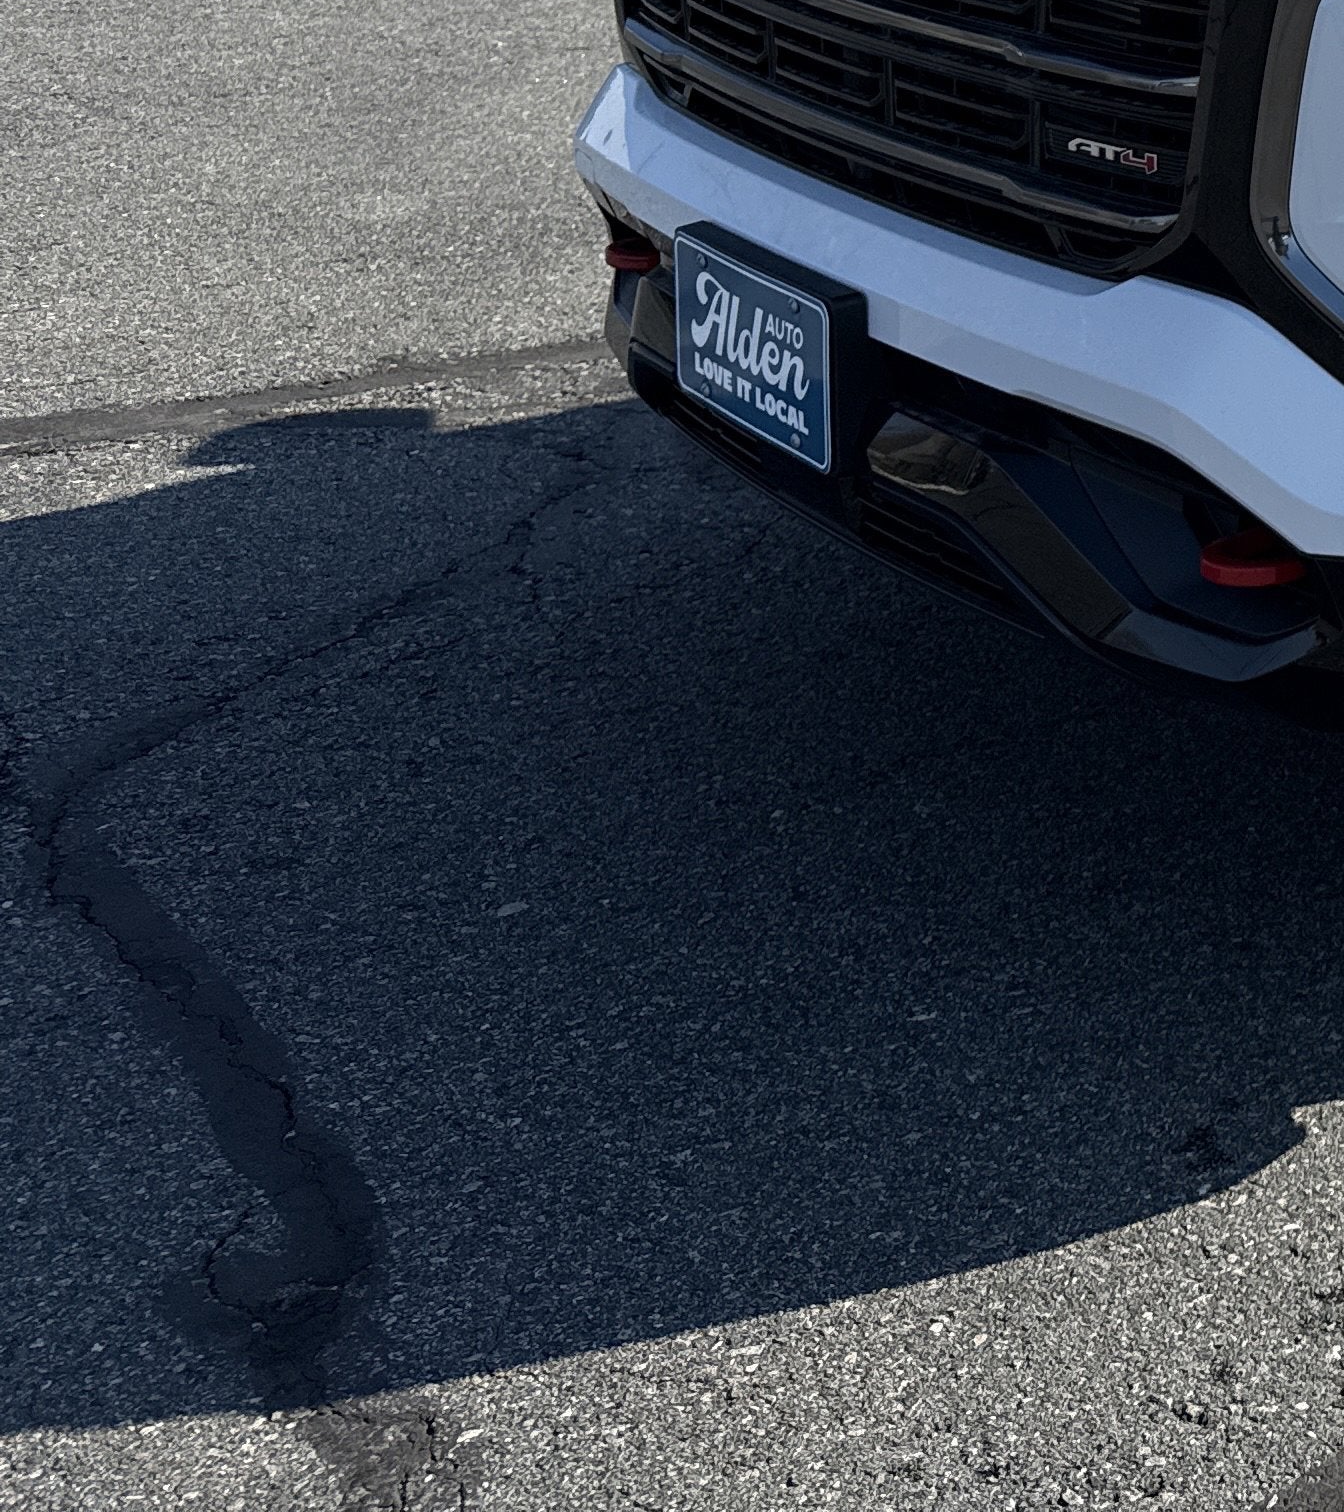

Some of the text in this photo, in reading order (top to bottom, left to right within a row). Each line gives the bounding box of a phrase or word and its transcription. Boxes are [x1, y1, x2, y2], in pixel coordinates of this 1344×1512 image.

[1068, 137, 1158, 175] AT4
[691, 271, 810, 400] Alden
[765, 314, 804, 350] AUTO
[694, 351, 809, 436] LOVE IT LOCAL
